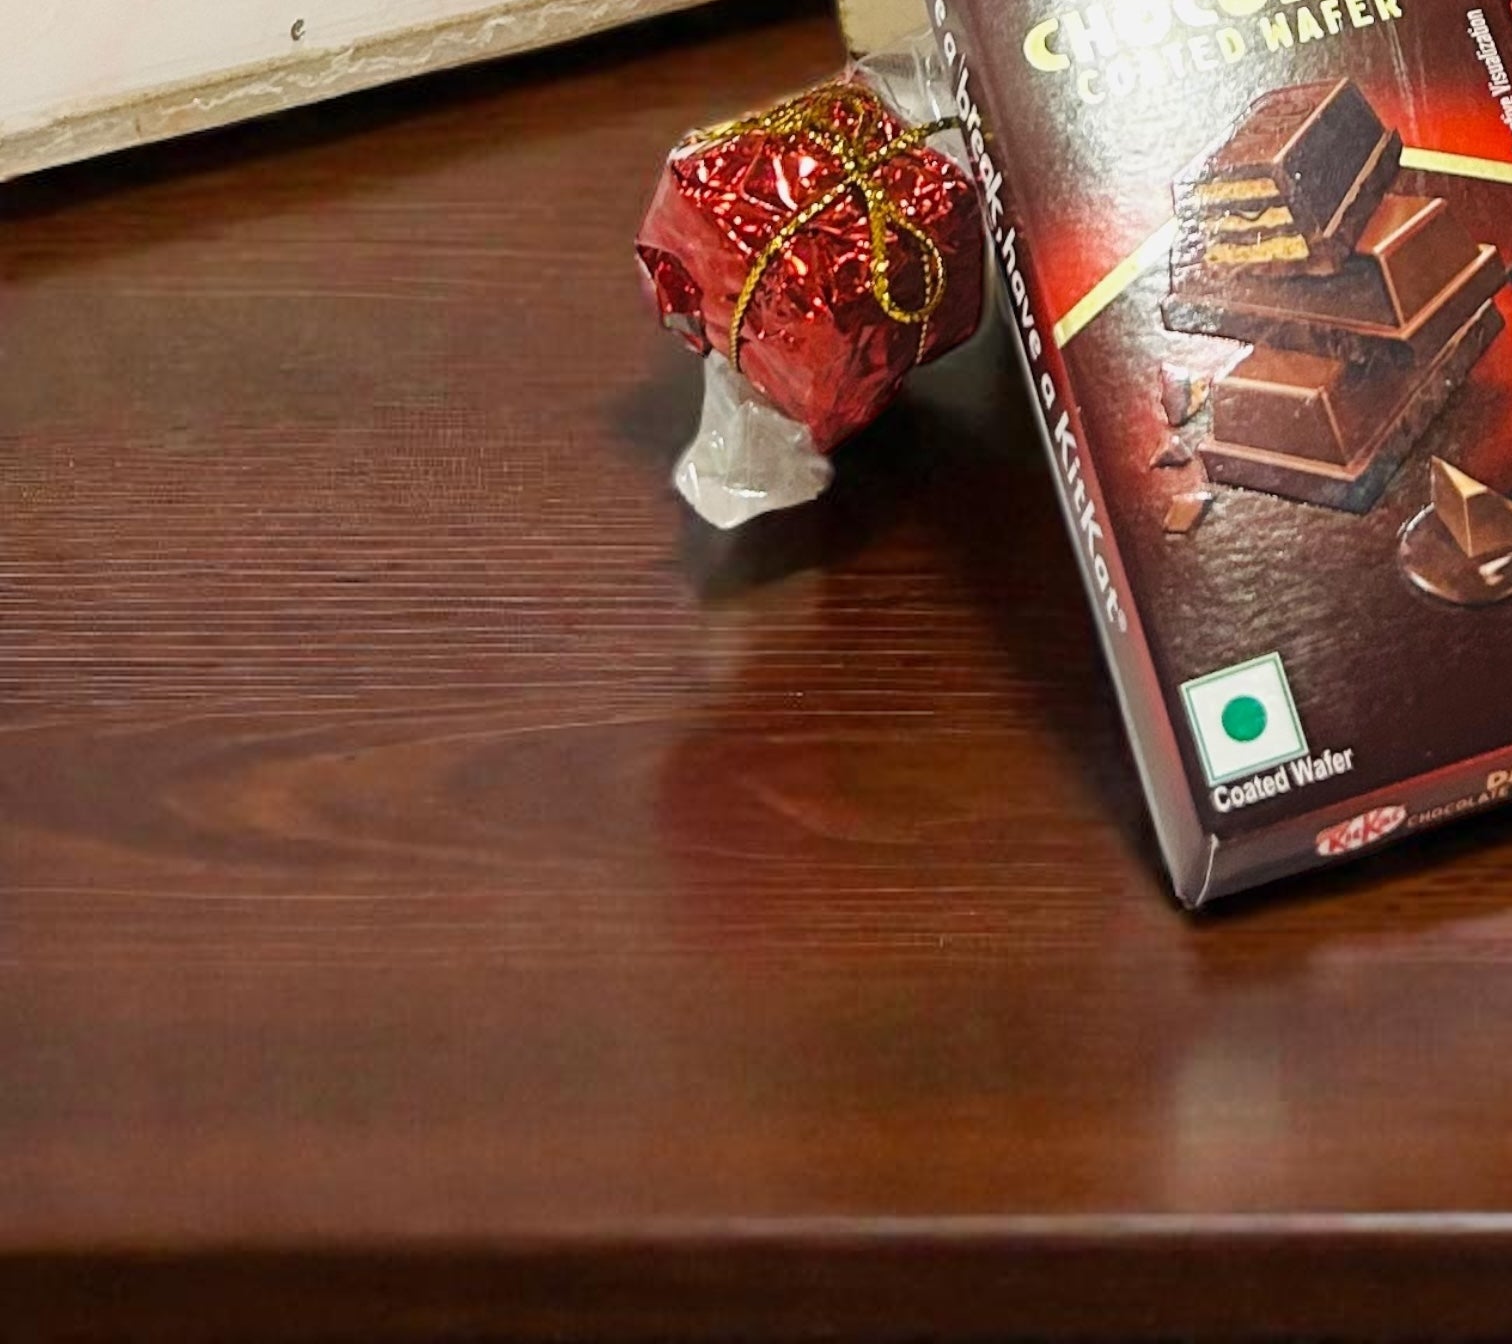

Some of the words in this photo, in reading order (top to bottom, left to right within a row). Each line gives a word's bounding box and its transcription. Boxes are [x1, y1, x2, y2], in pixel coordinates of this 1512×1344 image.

[1466, 8, 1511, 97] Visualization
[942, 31, 957, 66] a
[1001, 227, 1042, 361] have
[1040, 372, 1057, 408] a
[1212, 765, 1291, 812] Coated
[1290, 748, 1354, 787] Wafer
[1407, 785, 1509, 830] CHOCOLATE
